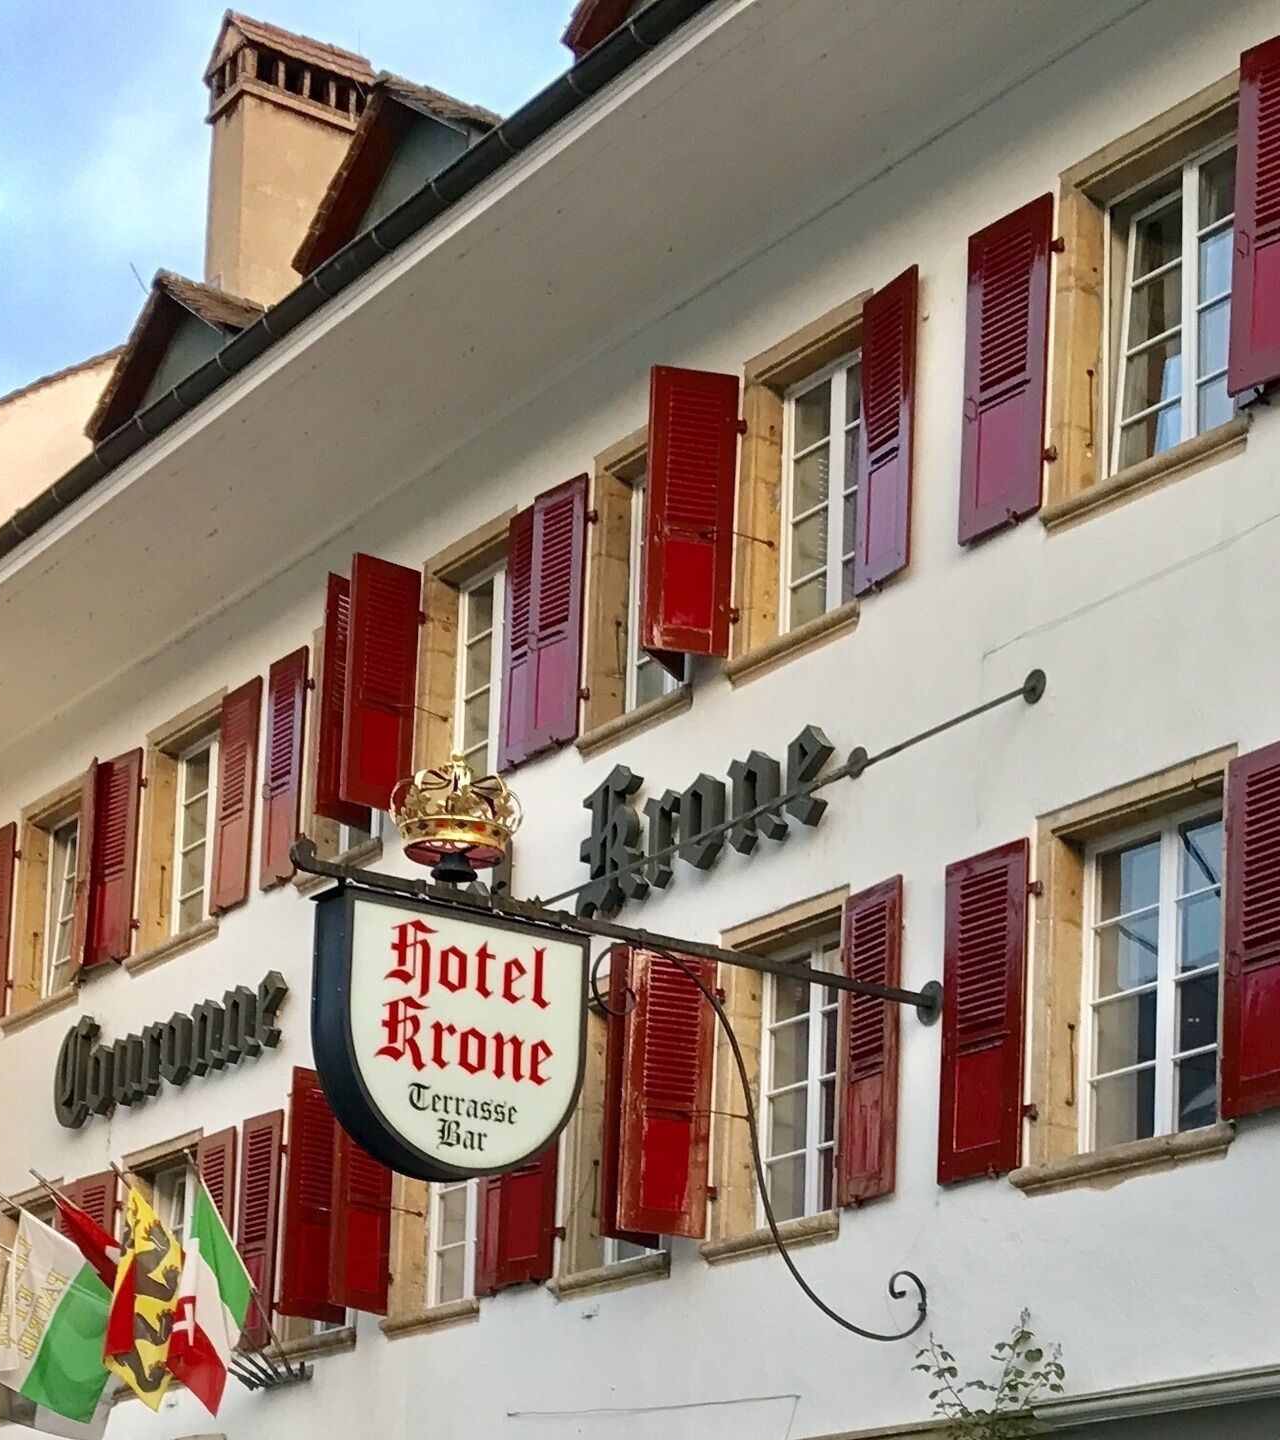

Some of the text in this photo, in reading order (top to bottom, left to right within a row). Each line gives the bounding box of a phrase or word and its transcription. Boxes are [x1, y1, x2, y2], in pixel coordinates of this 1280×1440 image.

[575, 724, 836, 920] Krone
[383, 918, 551, 1010] Hotel
[53, 969, 289, 1130] Couronne
[373, 995, 555, 1087] Krone
[407, 1082, 519, 1125] Terrasse
[436, 1117, 489, 1153] Bar
